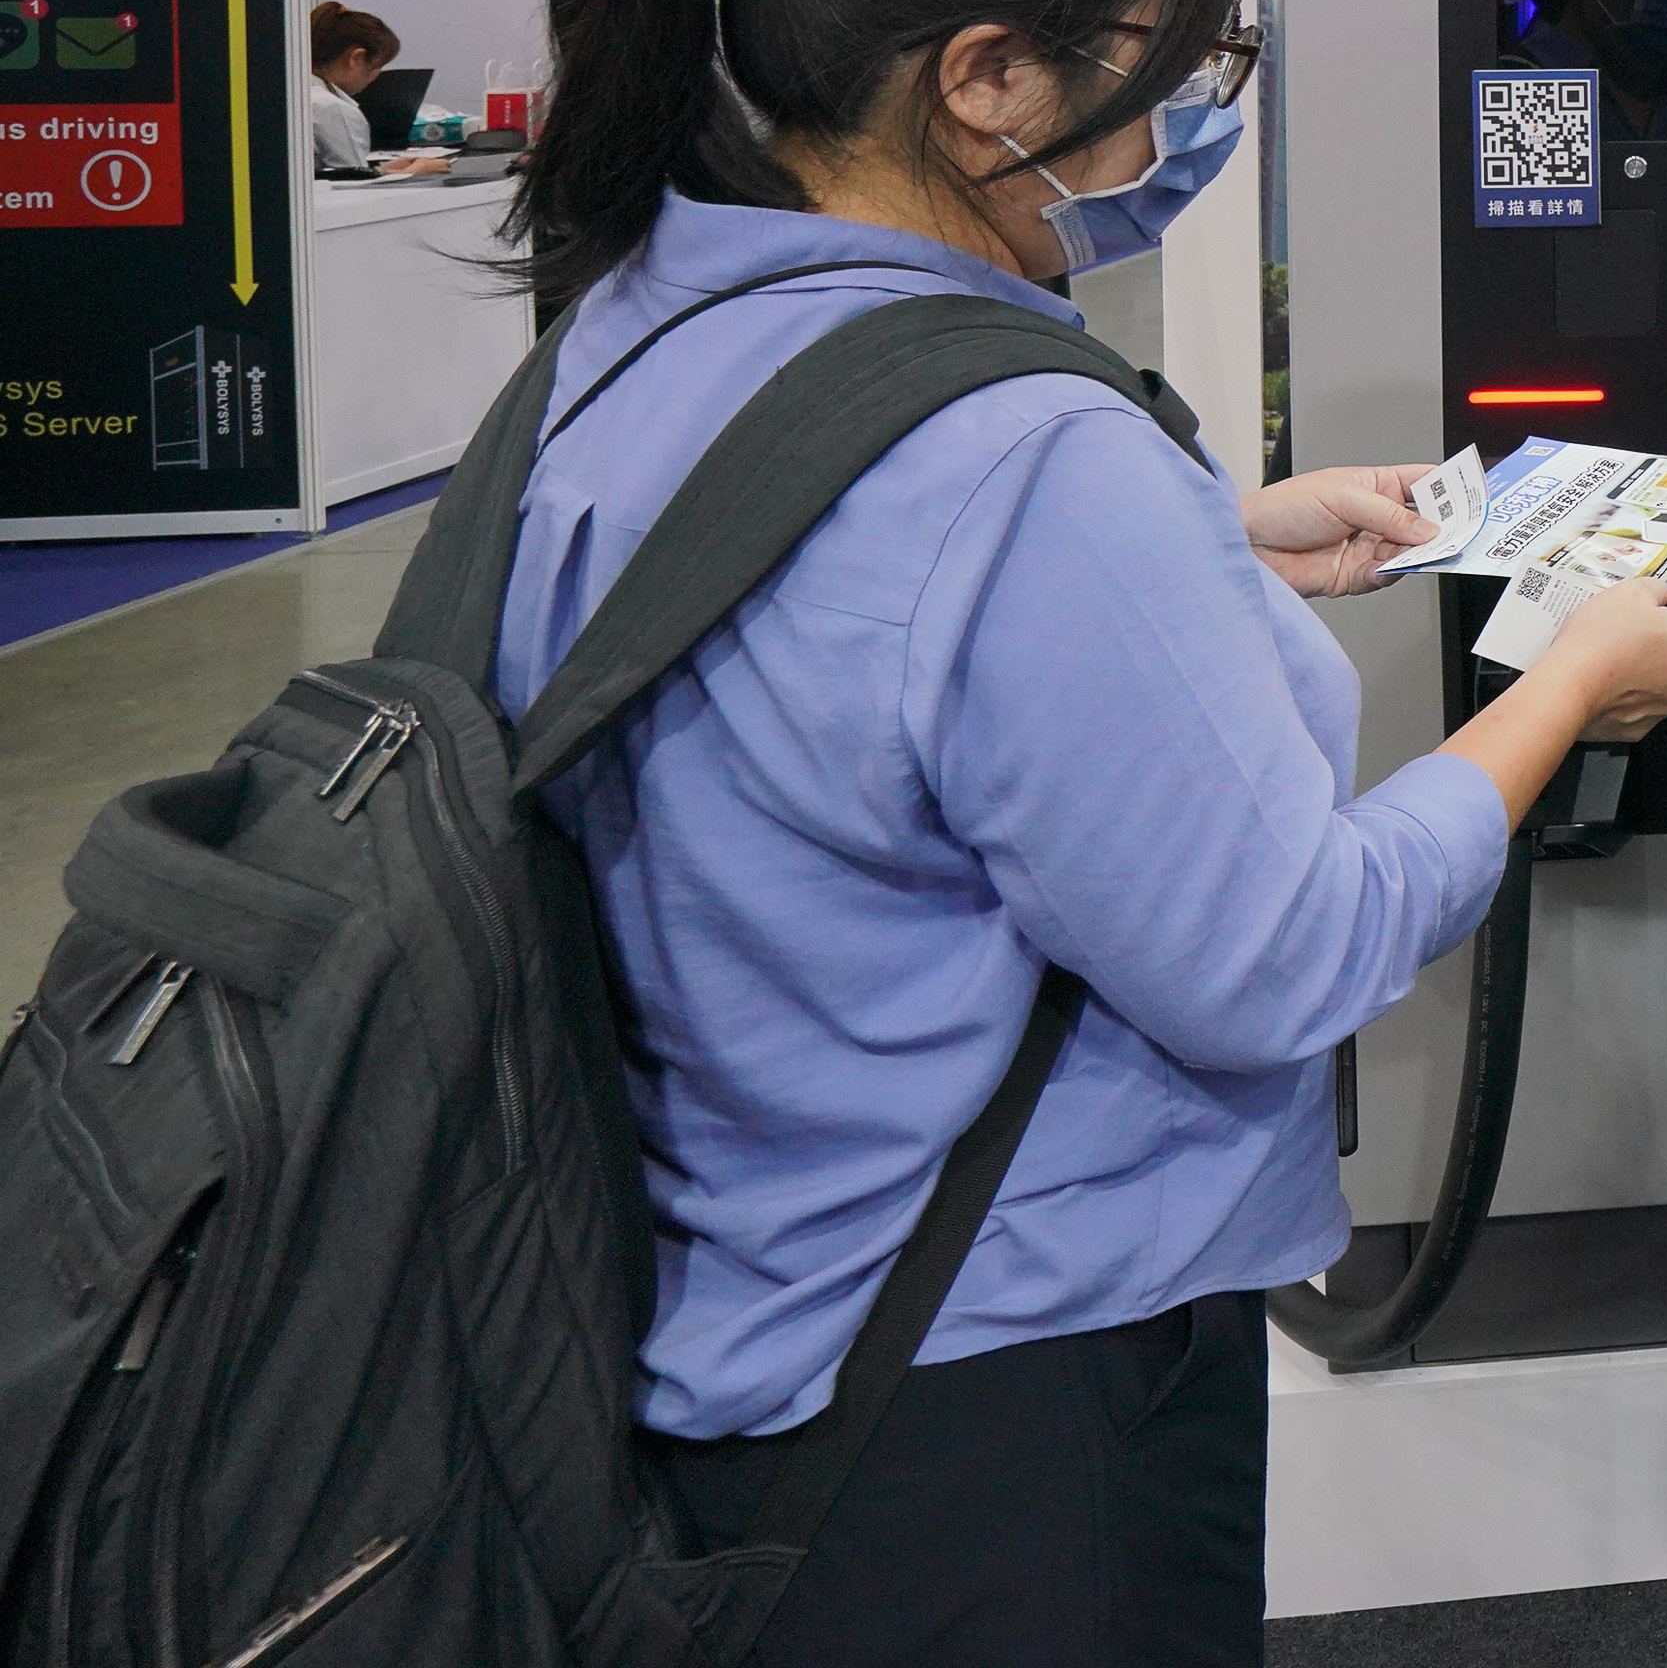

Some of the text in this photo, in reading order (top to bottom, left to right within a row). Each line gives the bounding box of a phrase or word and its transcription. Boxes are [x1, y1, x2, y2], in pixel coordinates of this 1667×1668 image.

[40, 116, 159, 145] driving
[1488, 199, 1584, 217] 掃描看詳情
[0, 379, 64, 406] sys
[214, 378, 230, 436] BOLYSYS
[250, 383, 264, 437] BOLYSYS
[23, 411, 138, 437] Server
[1480, 1020, 1488, 1033] DC
